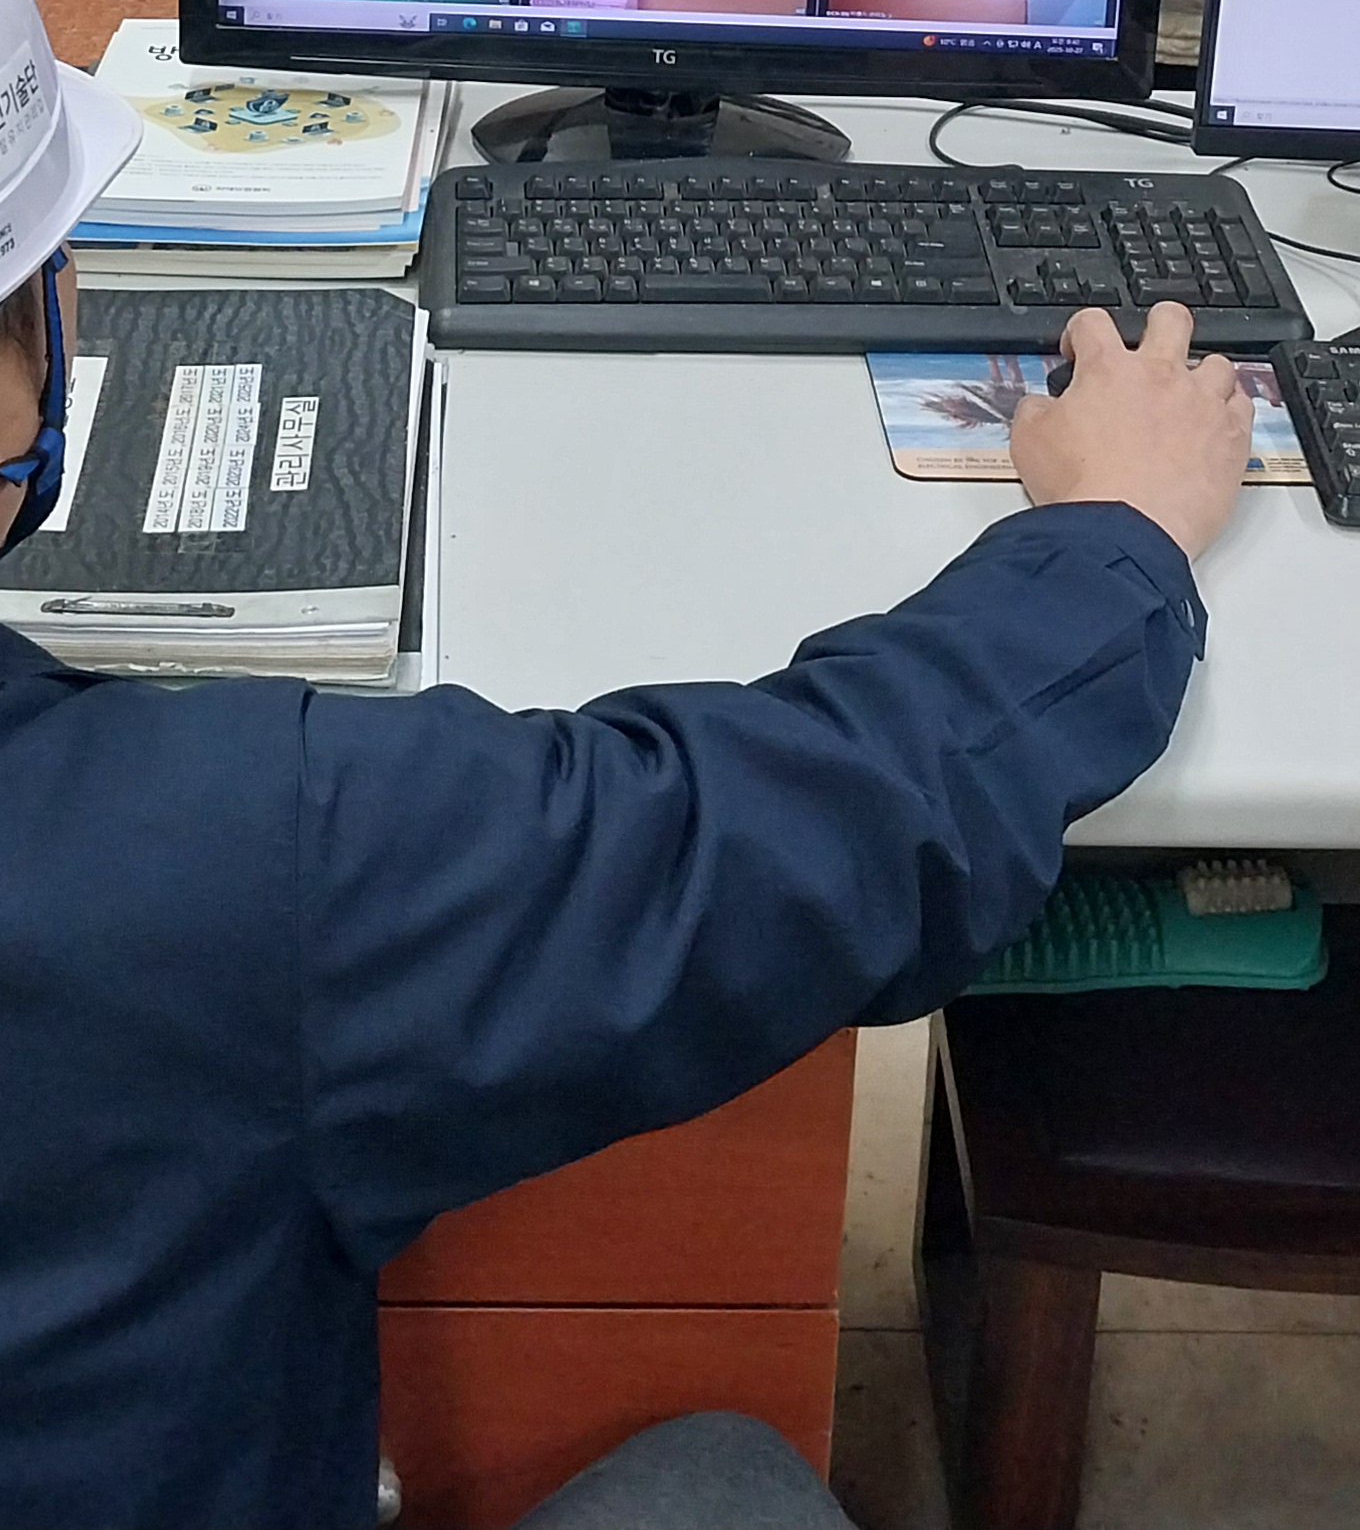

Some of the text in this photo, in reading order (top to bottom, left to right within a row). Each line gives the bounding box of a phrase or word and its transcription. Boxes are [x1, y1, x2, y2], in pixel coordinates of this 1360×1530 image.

[652, 49, 676, 66] TG
[1123, 178, 1154, 189] TG
[275, 400, 316, 487] 관리사무실
